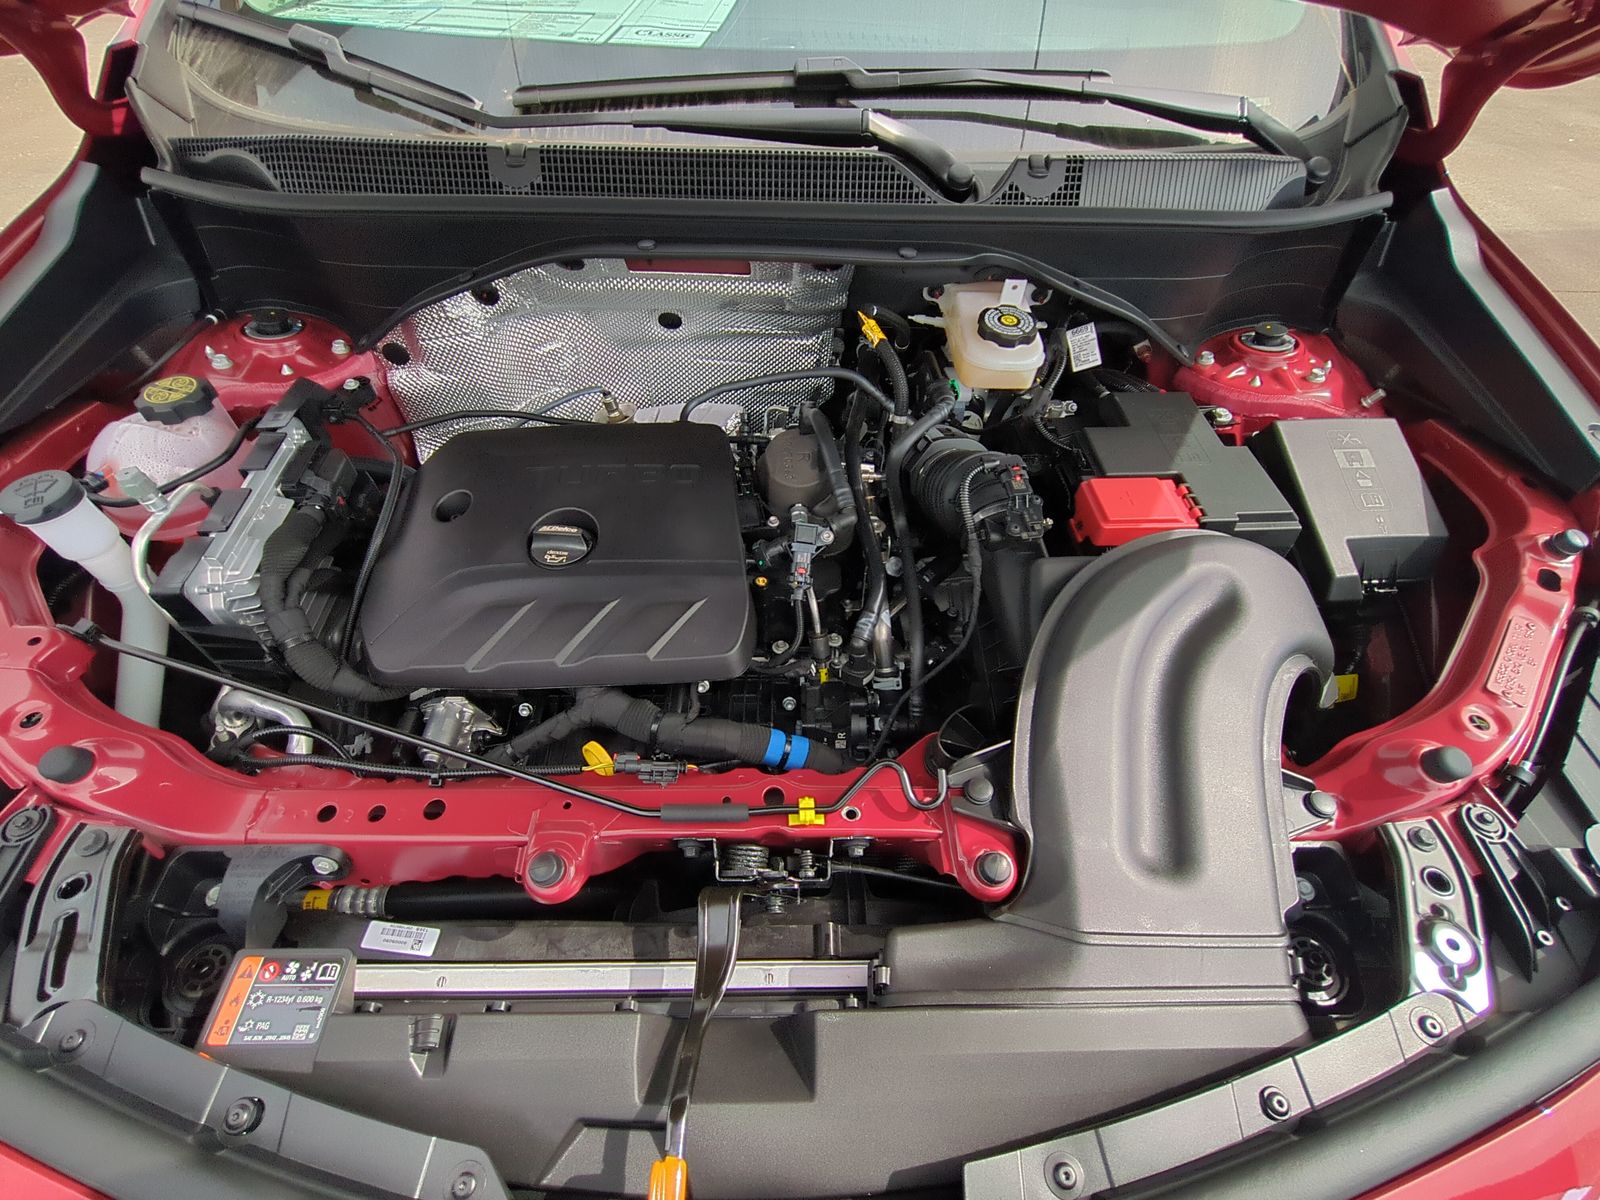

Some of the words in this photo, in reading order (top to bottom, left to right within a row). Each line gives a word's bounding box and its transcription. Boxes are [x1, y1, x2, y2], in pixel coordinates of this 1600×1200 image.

[266, 995, 295, 1005] R-1234yf
[314, 995, 323, 1004] kg
[256, 1021, 271, 1031] PAG
